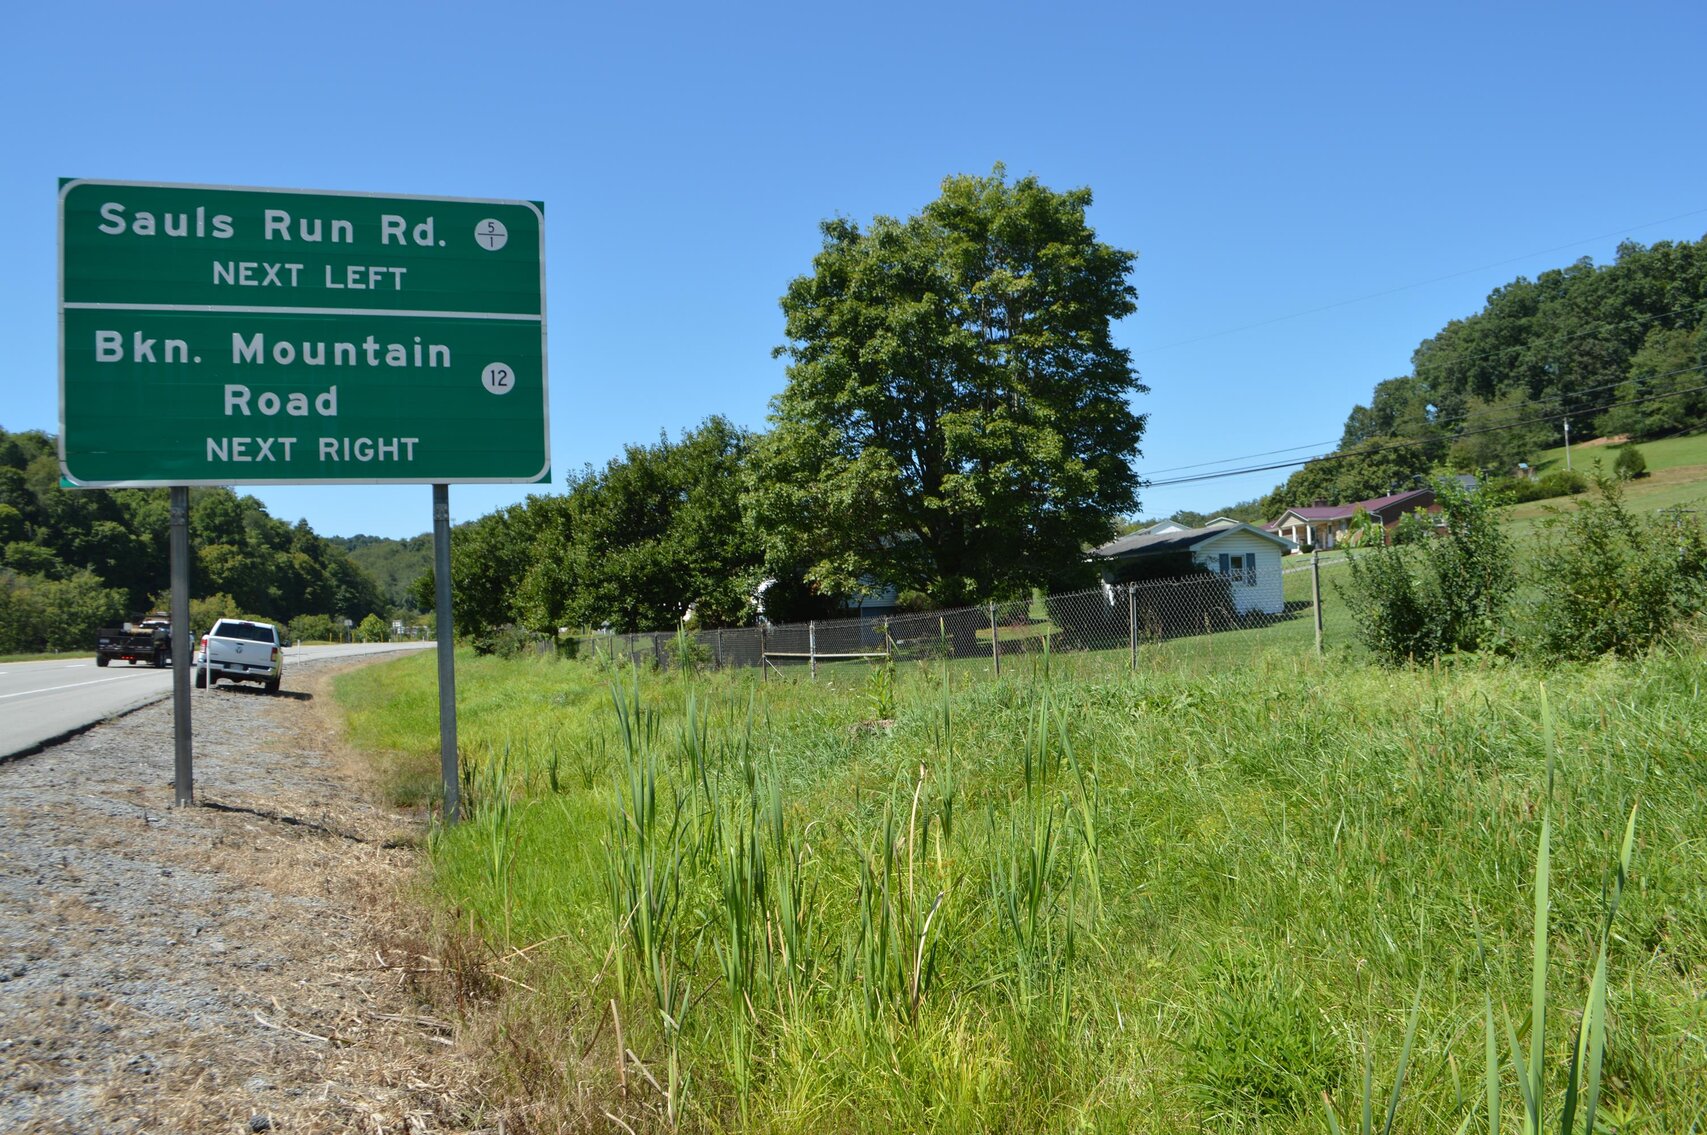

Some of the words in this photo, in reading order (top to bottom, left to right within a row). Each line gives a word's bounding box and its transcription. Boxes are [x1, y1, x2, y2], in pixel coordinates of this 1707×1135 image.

[98, 202, 234, 239] Sauls
[264, 209, 353, 243] Run
[381, 214, 446, 247] Rd.
[487, 221, 496, 234] 5
[213, 261, 304, 287] NEXT
[325, 265, 407, 290] LEFT
[95, 330, 201, 363] Bkn.
[232, 332, 451, 367] Mountain
[490, 369, 508, 387] 12
[224, 384, 338, 416] Road
[206, 437, 297, 462] NEXT
[319, 437, 419, 462] RIGHT
